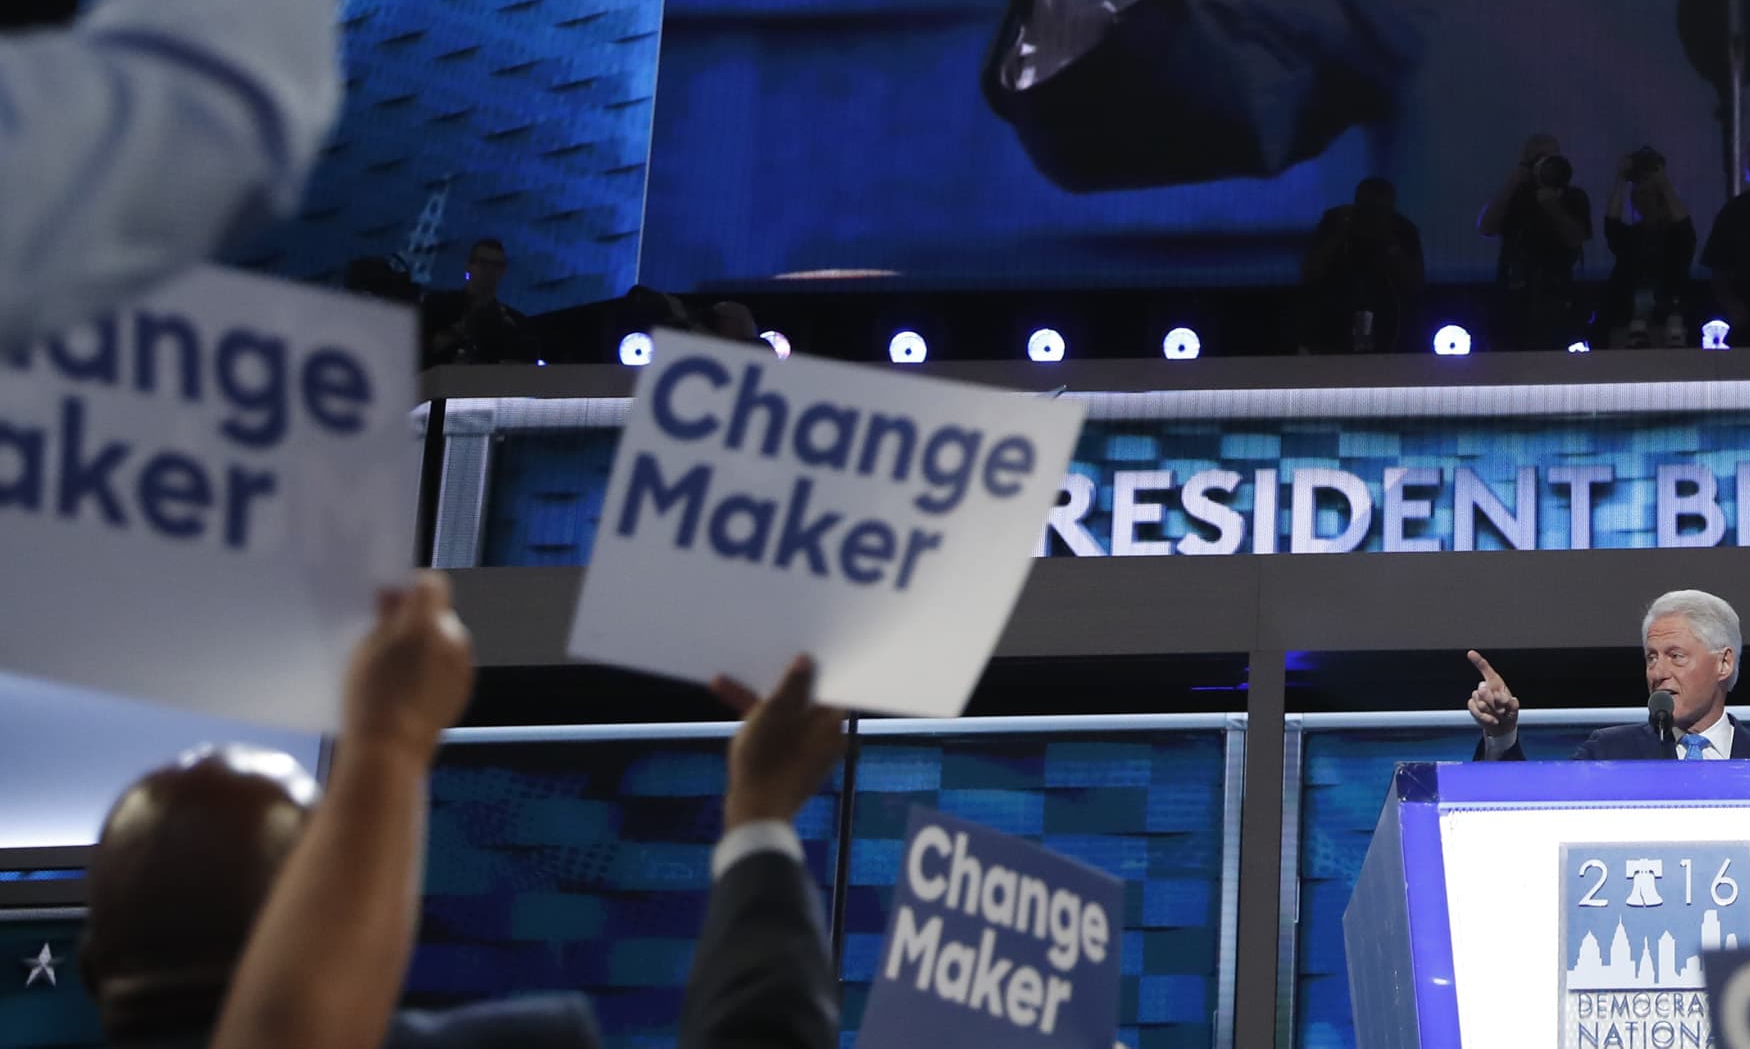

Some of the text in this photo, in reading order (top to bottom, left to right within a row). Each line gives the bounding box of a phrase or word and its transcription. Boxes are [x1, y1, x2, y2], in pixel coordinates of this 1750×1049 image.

[0, 303, 373, 448] ange
[650, 355, 1037, 515] Change
[0, 394, 277, 550] aker
[617, 453, 943, 592] Maker
[1032, 464, 1614, 557] RESIDENT
[908, 825, 1110, 971] Change
[1578, 858, 1739, 908] 216
[885, 905, 1072, 1035] Maker
[1578, 992, 1709, 1019] DEMOCRA
[1578, 1021, 1713, 1049] NATION
